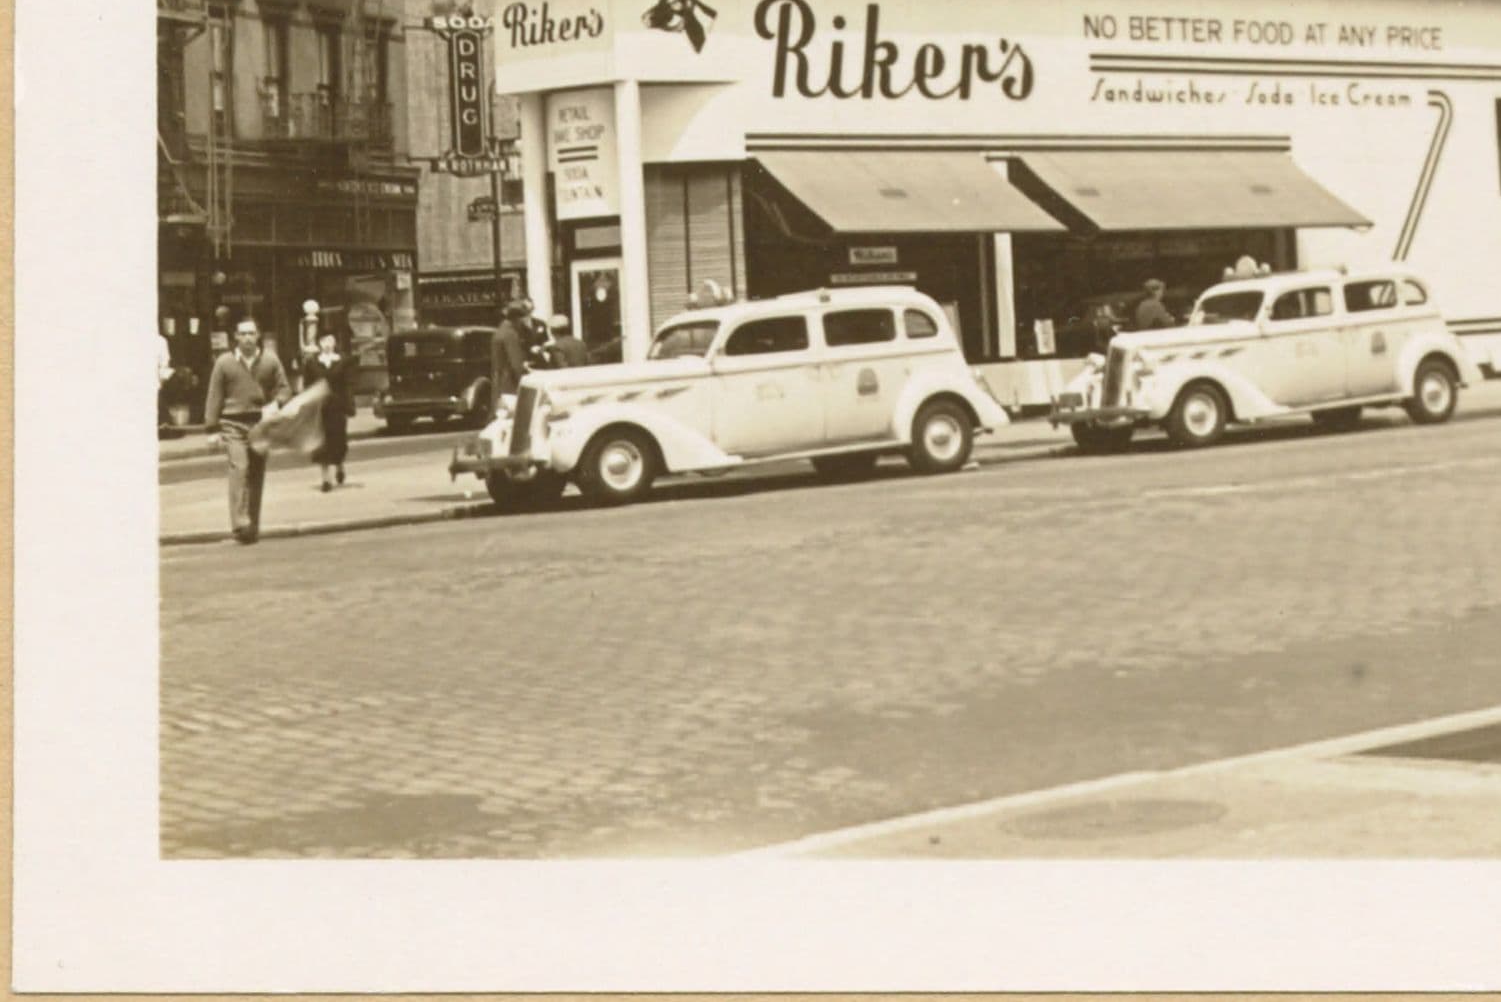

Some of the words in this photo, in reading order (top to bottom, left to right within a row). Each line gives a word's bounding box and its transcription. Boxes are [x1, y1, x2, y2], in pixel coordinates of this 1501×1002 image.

[502, 1, 604, 49] Riker's
[1083, 14, 1117, 40] NO
[1129, 15, 1222, 43] BETTER
[1233, 19, 1294, 46] FOOD
[1304, 23, 1327, 45] AT
[1338, 24, 1377, 47] ANY
[1386, 26, 1442, 51] PRICE
[458, 39, 478, 126] DRUG
[1090, 77, 1226, 103] Sandwiches
[1245, 80, 1293, 105] Soda
[1311, 82, 1340, 105] Ice
[1347, 82, 1412, 106] Cream
